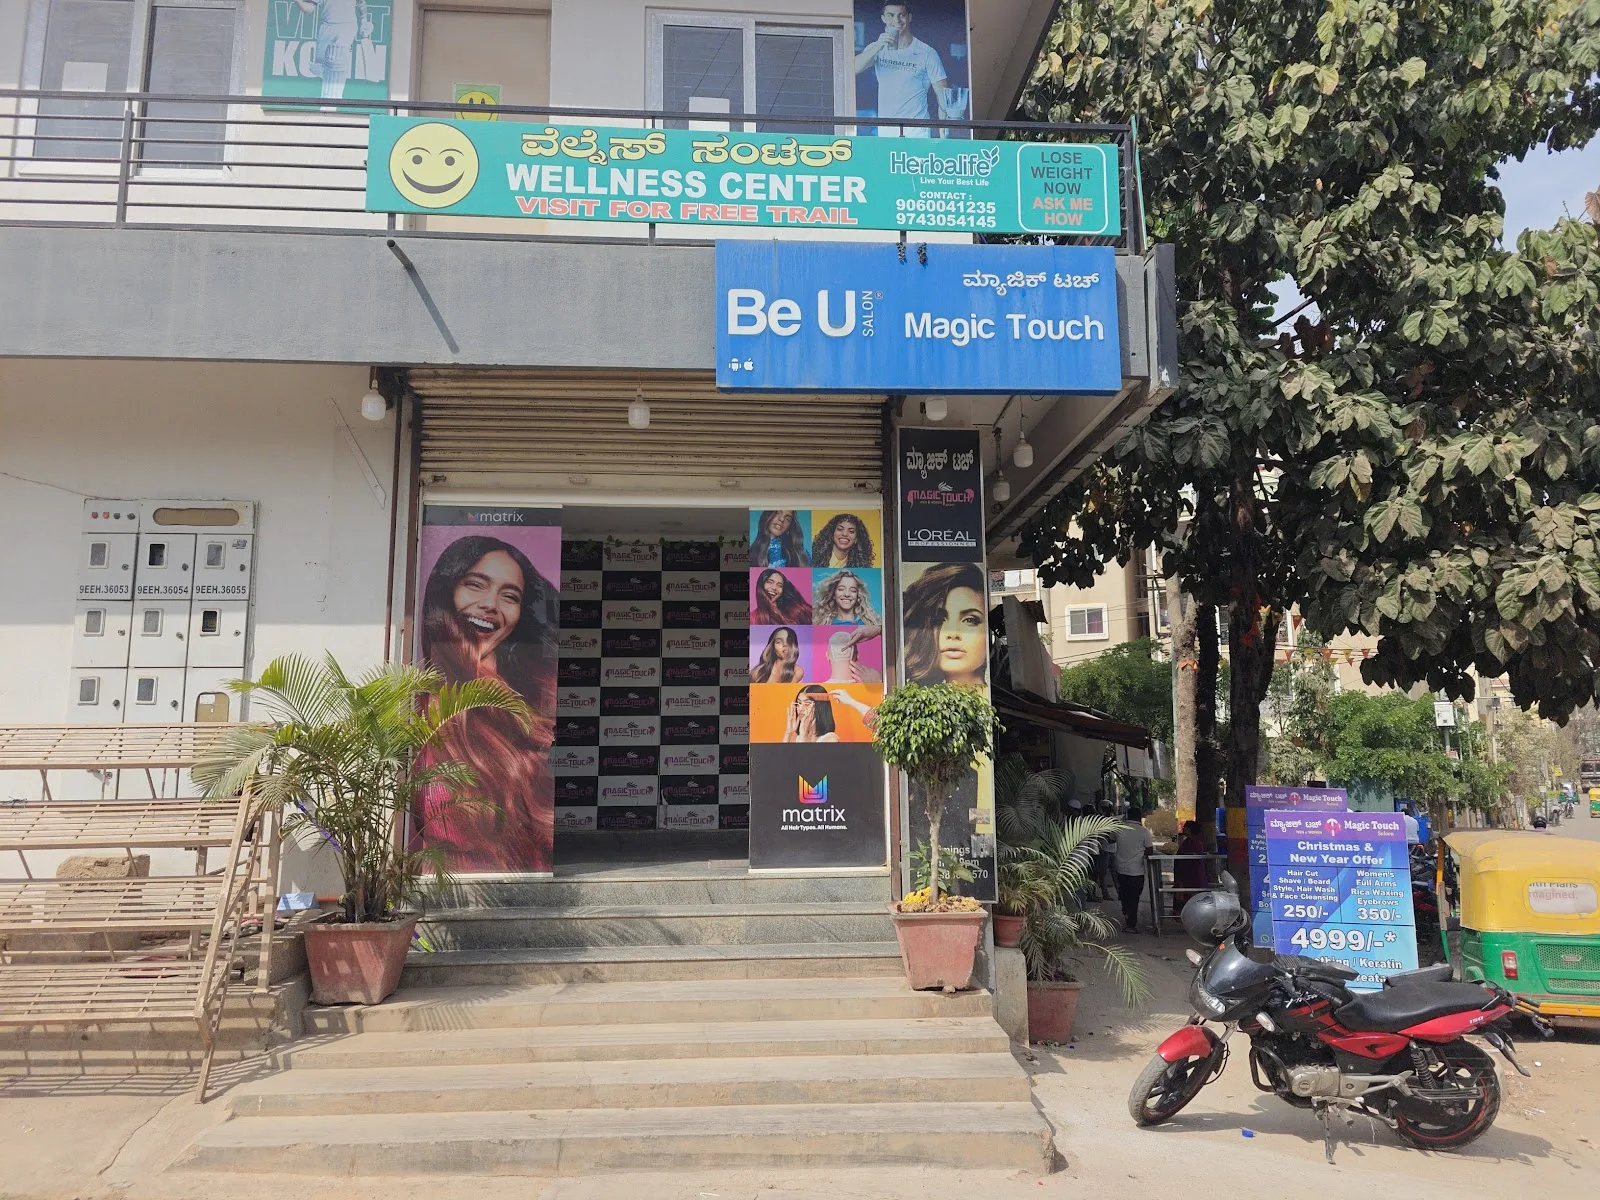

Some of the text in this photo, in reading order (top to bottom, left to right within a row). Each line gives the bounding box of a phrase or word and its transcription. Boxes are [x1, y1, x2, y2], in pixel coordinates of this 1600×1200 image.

[880, 58, 918, 68] HERBALIFE
[890, 152, 991, 176] Herbalife
[1041, 152, 1082, 164] LOSE
[1030, 166, 1092, 180] WEIGHT
[506, 164, 867, 203] WELLNESS CENTER
[1044, 182, 1082, 194] NOW
[920, 192, 966, 200] CONTACT
[515, 196, 858, 224] VISIT FOR FREE TRAIL
[896, 200, 996, 214] 9060041235
[1032, 198, 1092, 211] ASK ME
[896, 214, 996, 228] 9743054145
[1044, 212, 1082, 226] HOW
[1054, 272, 1099, 288] ಟಚ್
[728, 289, 856, 336] Be U
[862, 290, 874, 336] SALON
[904, 312, 1104, 346] Magic Touch
[908, 489, 974, 506] MAGIC TOUCH
[480, 512, 524, 522] matrix
[908, 528, 976, 541] L'ORÉAL
[79, 584, 129, 594] 9EEH.36053
[137, 585, 188, 595] 9EEH.36054
[196, 585, 246, 595] 9EEH.36055
[1303, 794, 1322, 802] Magic
[782, 805, 846, 822] matrix
[1344, 820, 1400, 831] Magic Touch
[1298, 841, 1374, 852] Christmas &
[1290, 854, 1384, 865] New Year Offer
[1300, 894, 1338, 902] Cleansing
[1372, 890, 1404, 898] Waxing
[1284, 904, 1328, 918] 250/-
[1358, 908, 1402, 920] 350/-
[1360, 958, 1402, 969] Keratin
